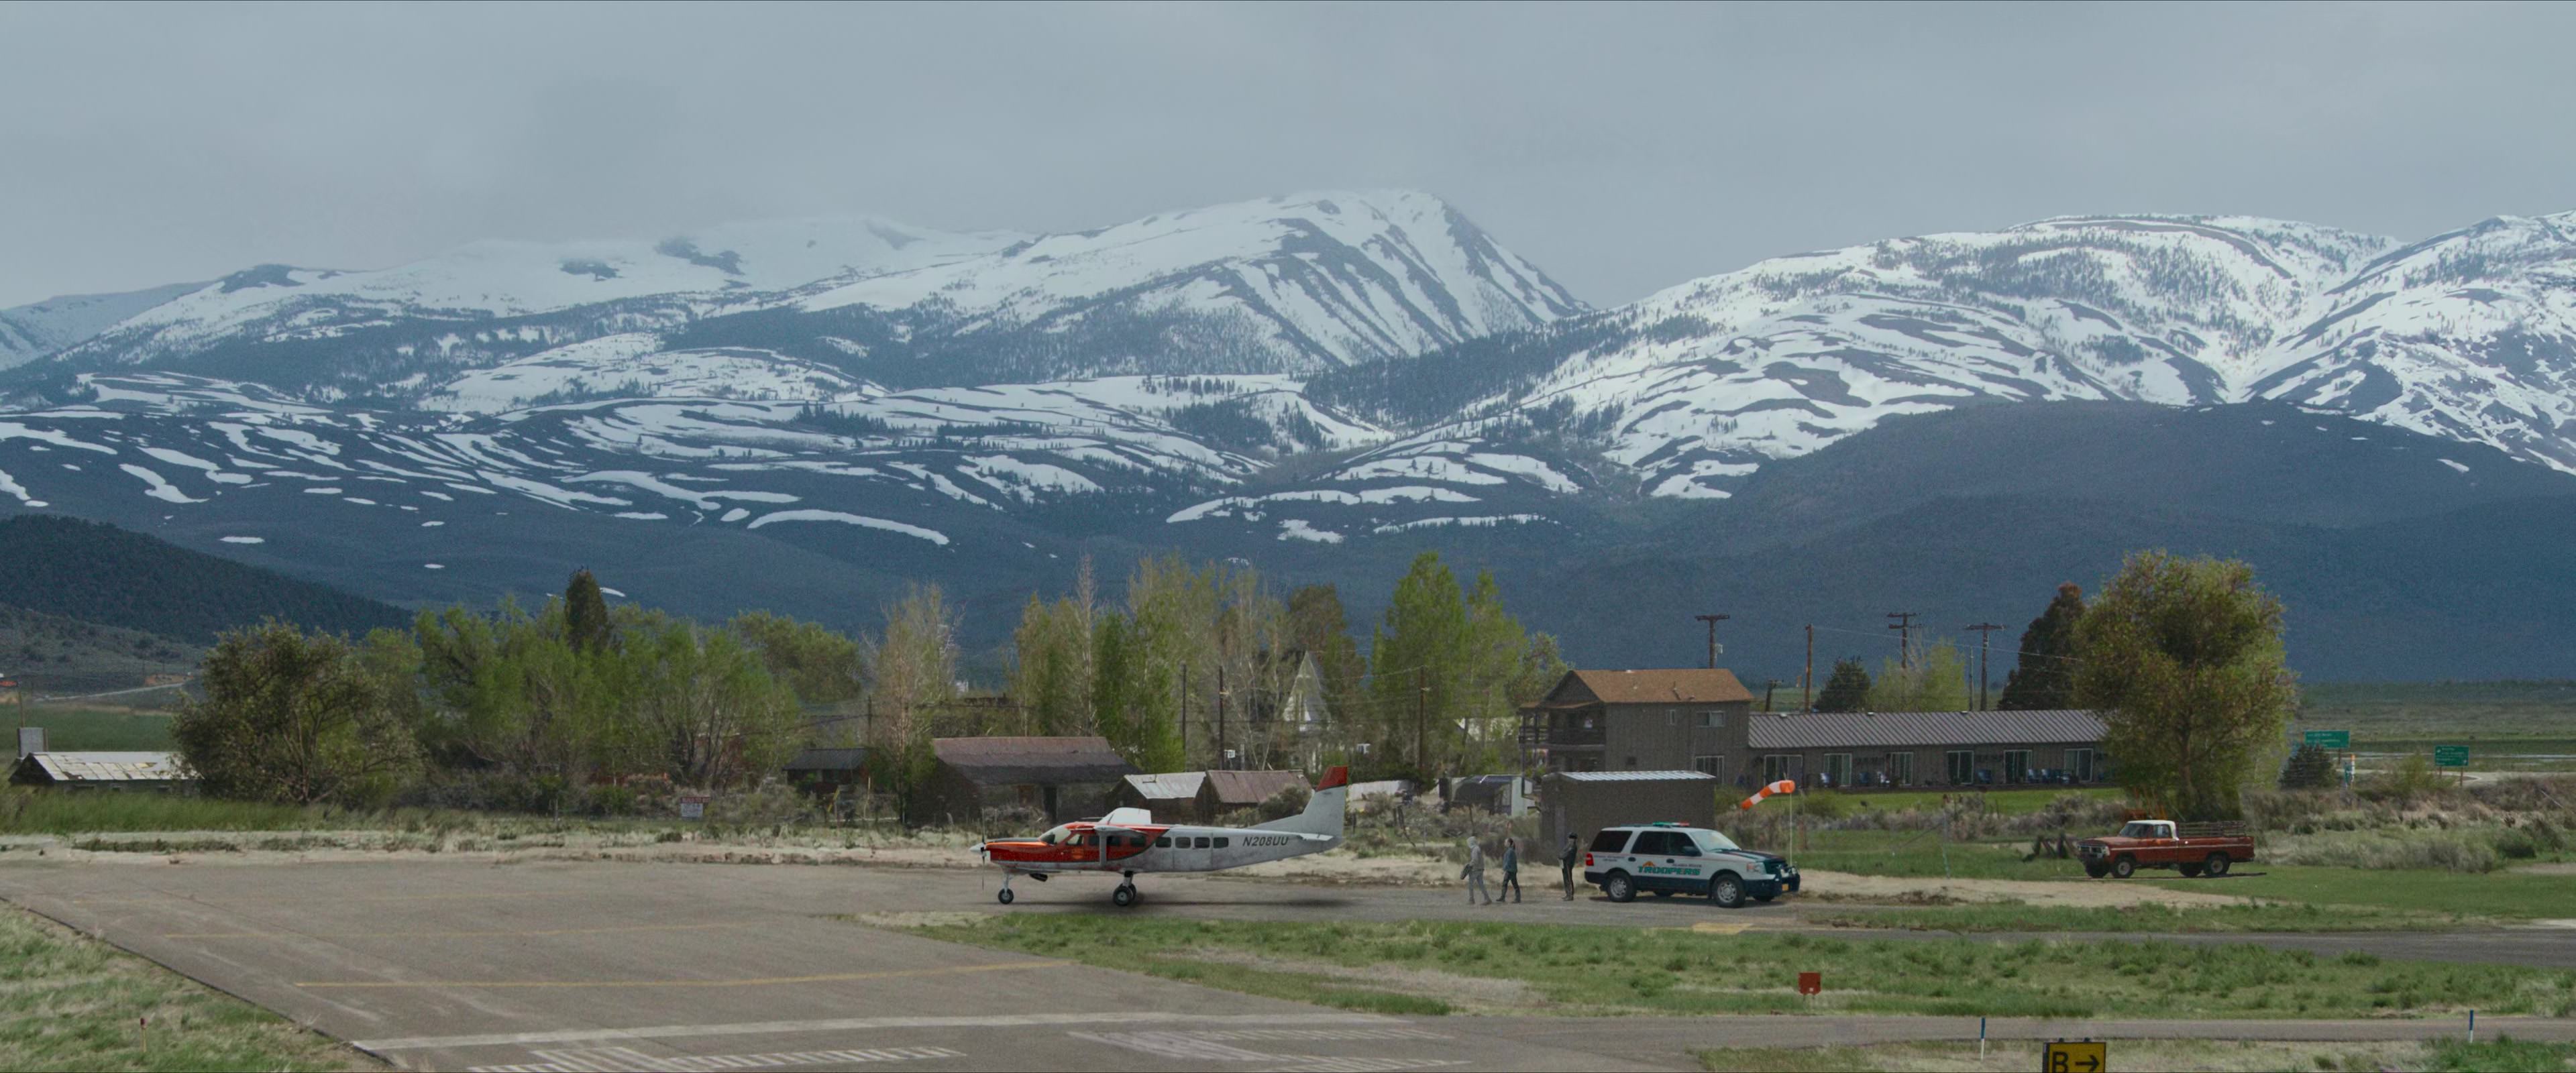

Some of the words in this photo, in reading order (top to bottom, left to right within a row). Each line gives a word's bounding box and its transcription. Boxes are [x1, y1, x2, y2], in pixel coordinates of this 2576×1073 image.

[1242, 836, 1289, 846] N208UU
[1638, 866, 1701, 875] TROOPERS
[2052, 1052, 2068, 1072] B
